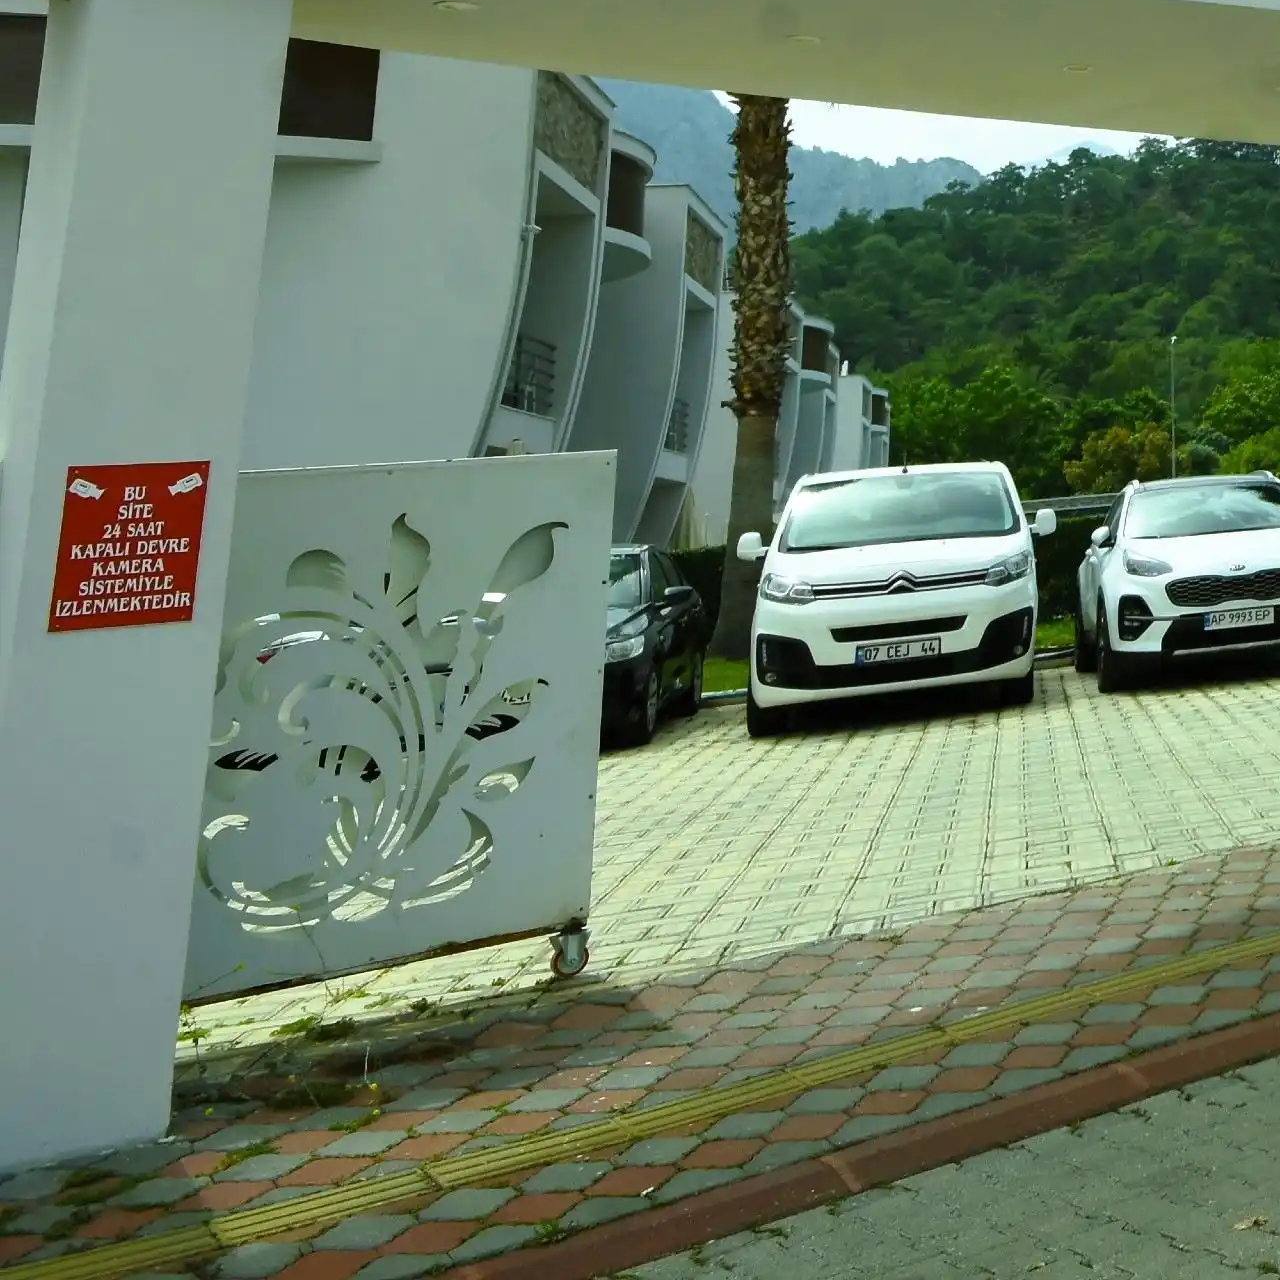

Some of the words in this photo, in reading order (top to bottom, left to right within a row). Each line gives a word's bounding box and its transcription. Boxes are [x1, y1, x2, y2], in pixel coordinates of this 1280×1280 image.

[124, 486, 147, 502] BU
[117, 503, 153, 520] SİTE
[103, 524, 121, 539] 24
[127, 521, 165, 538] SAAT
[70, 542, 130, 560] KAPALI
[136, 537, 190, 556] DEVRE
[91, 558, 164, 577] KAMERA
[78, 575, 174, 597] SİSTEMİYLE
[55, 592, 191, 617] İZLENMEKTEDİR
[1211, 613, 1226, 625] AP
[1228, 610, 1253, 624] 9993
[1255, 609, 1271, 621] EP
[864, 647, 880, 661] 07
[886, 643, 910, 659] CEJ
[921, 641, 936, 655] 44
